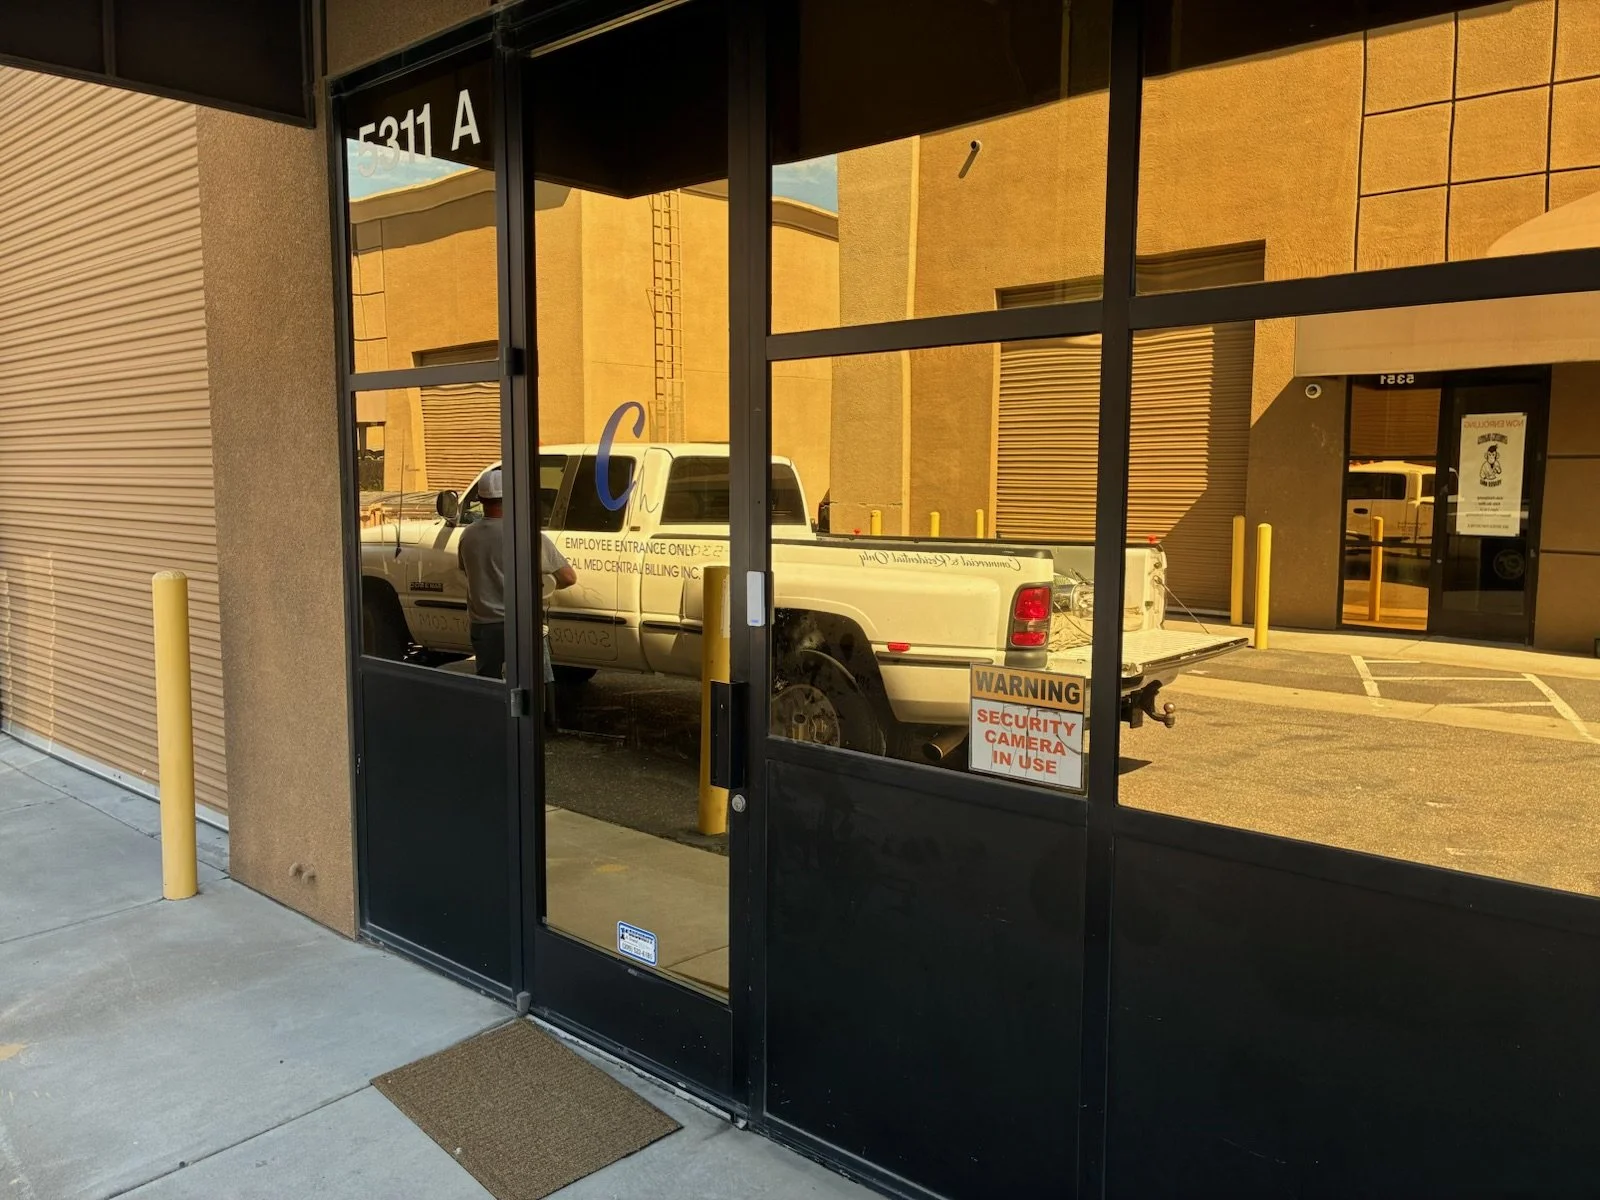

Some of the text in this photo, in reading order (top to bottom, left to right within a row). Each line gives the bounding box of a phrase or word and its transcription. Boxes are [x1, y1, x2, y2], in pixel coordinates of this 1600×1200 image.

[358, 88, 480, 177] 5311 A
[565, 538, 696, 556] EMPLOYEE ENTRANCE ONLY
[584, 558, 603, 571] MED
[604, 560, 642, 574] CENTRAL
[645, 563, 680, 578] BILLING
[681, 566, 700, 580] INC.
[975, 670, 1080, 704] WARNING
[977, 709, 1076, 737] SECURITY
[985, 730, 1066, 756] CAMERA
[993, 750, 1056, 774] IN USE
